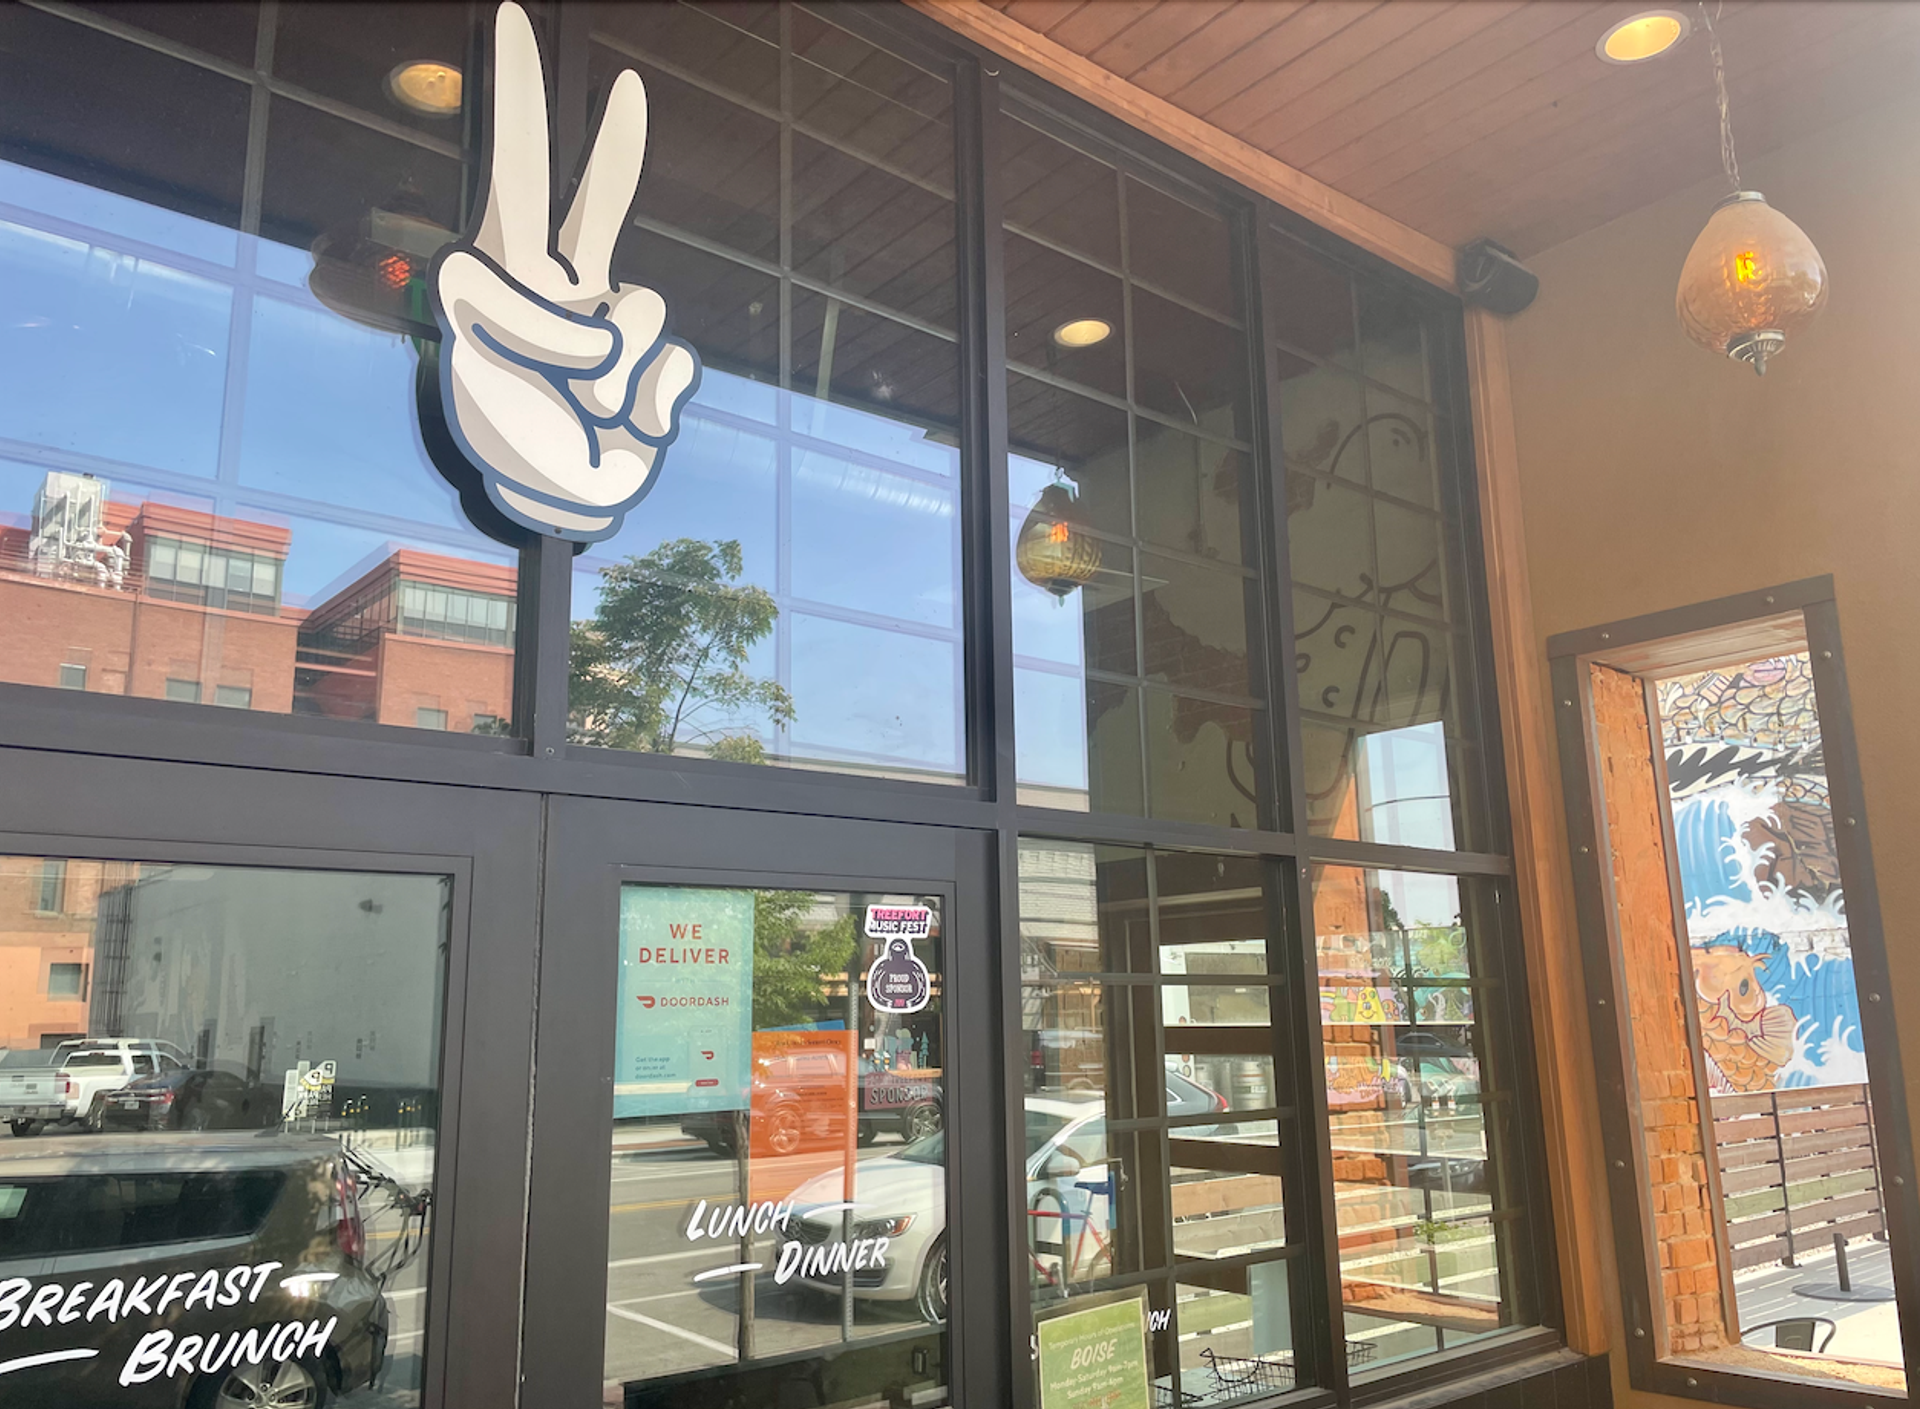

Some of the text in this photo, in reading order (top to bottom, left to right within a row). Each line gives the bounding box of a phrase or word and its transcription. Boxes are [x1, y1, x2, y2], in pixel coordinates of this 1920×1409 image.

[871, 908, 929, 920] TREEFORT
[669, 924, 702, 939] WE
[901, 921, 928, 933] FEST
[639, 948, 729, 964] DELIVER
[660, 997, 729, 1007] DOORDASH
[685, 1200, 795, 1241] LUNCH
[774, 1238, 889, 1285] DINNER
[0, 1261, 282, 1331] BREAKFAST
[119, 1316, 338, 1387] BRUNCH
[1070, 1338, 1118, 1370] BOISE
